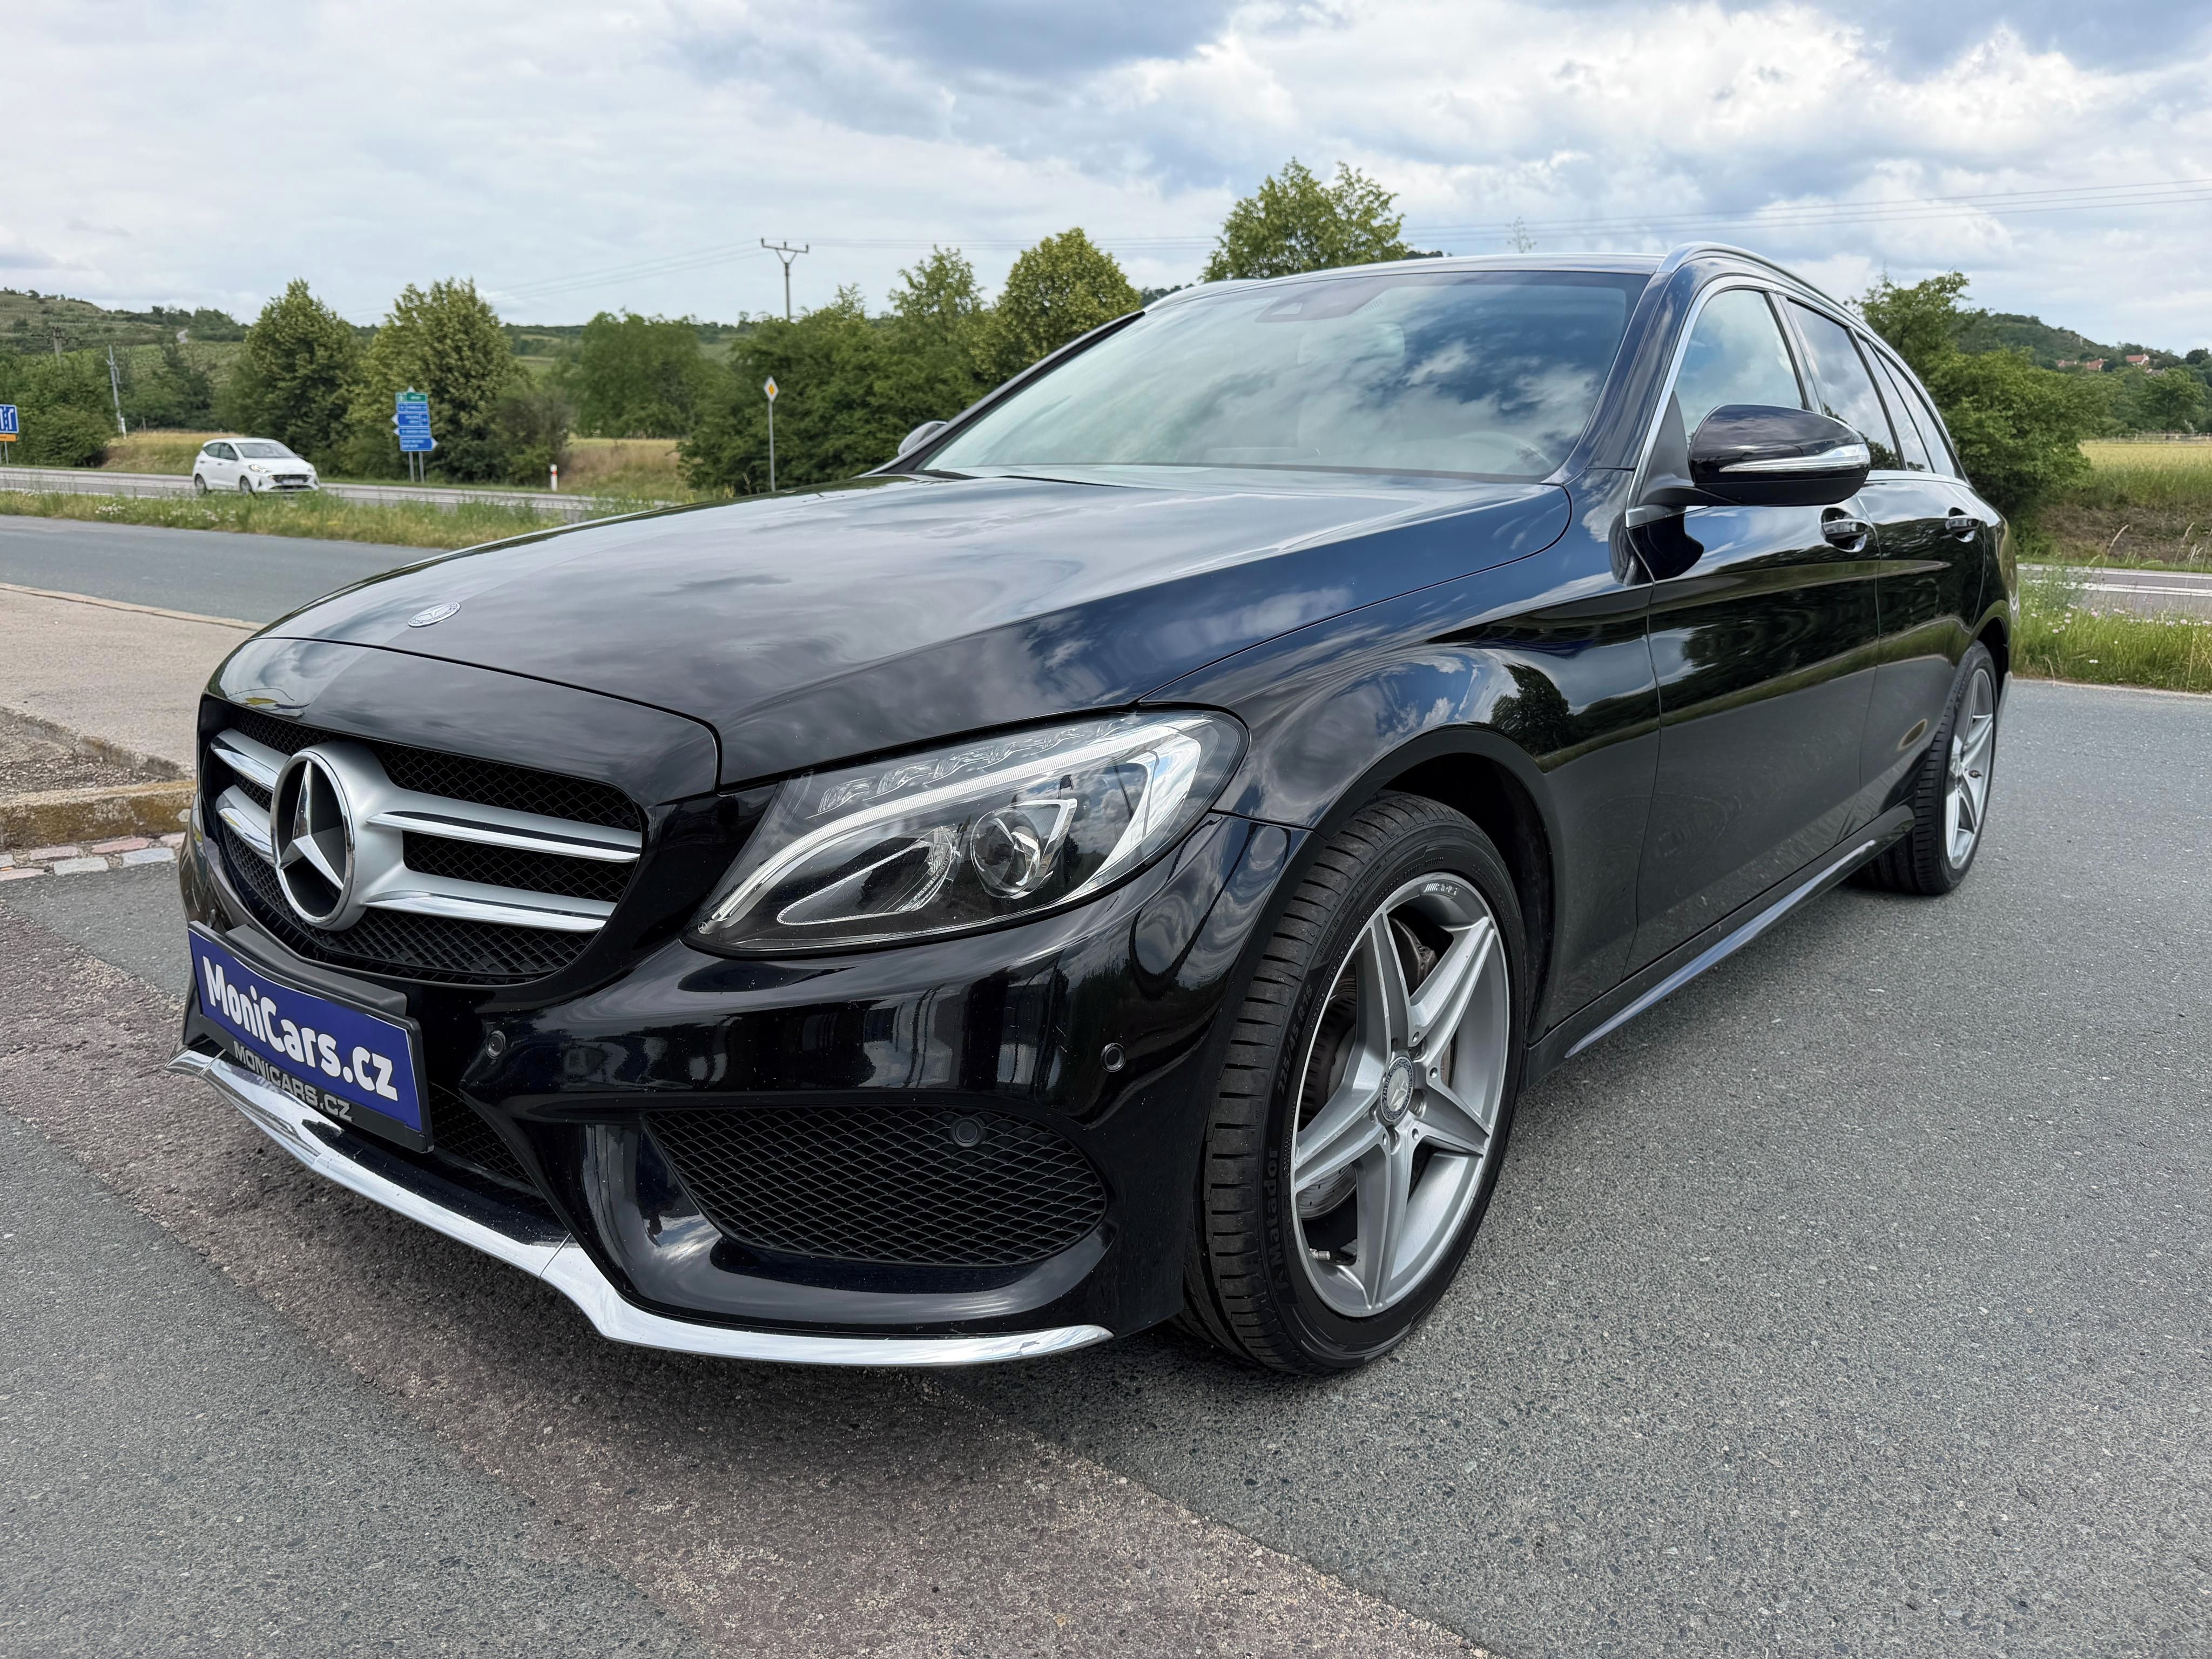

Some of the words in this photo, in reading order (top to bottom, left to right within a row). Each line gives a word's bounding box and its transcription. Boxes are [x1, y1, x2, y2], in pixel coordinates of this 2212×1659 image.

[202, 955, 399, 1102] MoniCars.cz
[1278, 1023, 1299, 1096] 225/45
[233, 1041, 354, 1122] MONICARS.CZ
[1263, 1148, 1284, 1267] Matador
